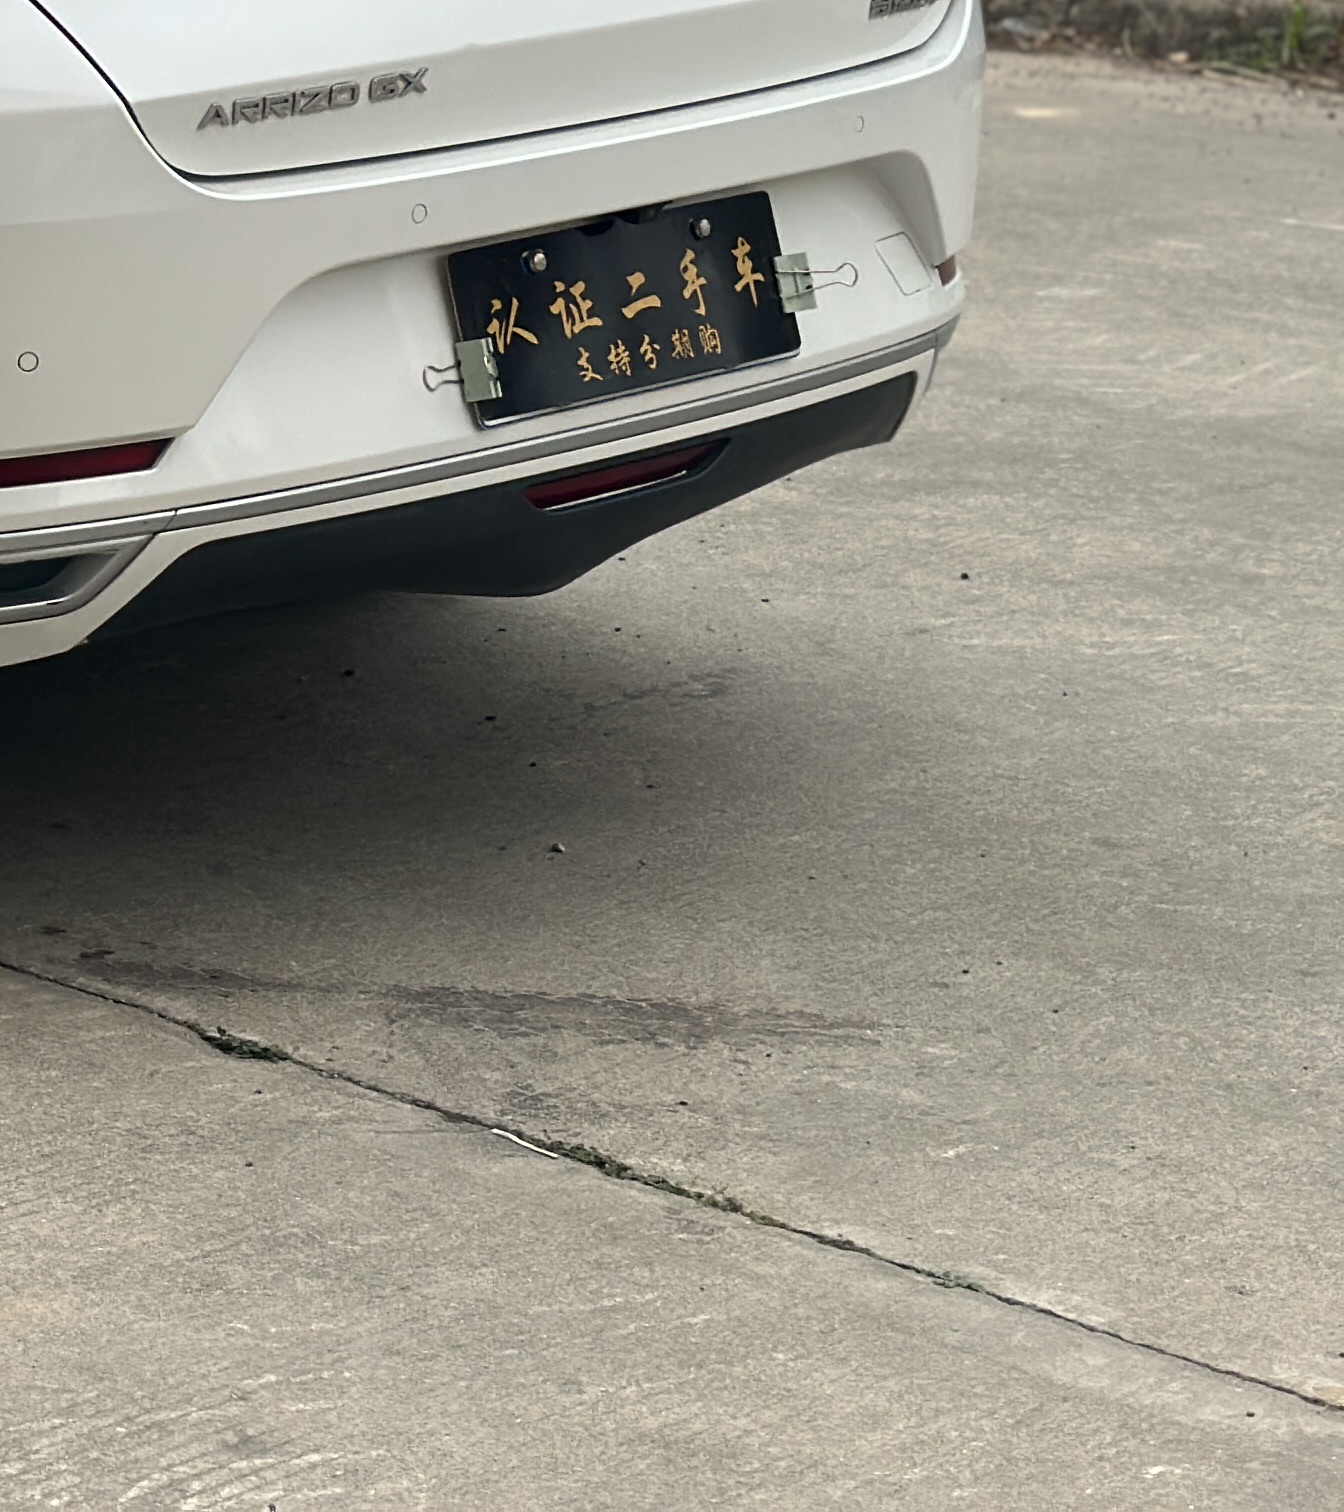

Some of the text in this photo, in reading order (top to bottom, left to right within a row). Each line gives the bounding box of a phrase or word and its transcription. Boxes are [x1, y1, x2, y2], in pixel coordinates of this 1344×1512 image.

[195, 66, 430, 132] ARRIZO GX
[485, 235, 766, 356] 认证二手车
[575, 324, 724, 384] 支持分期购
